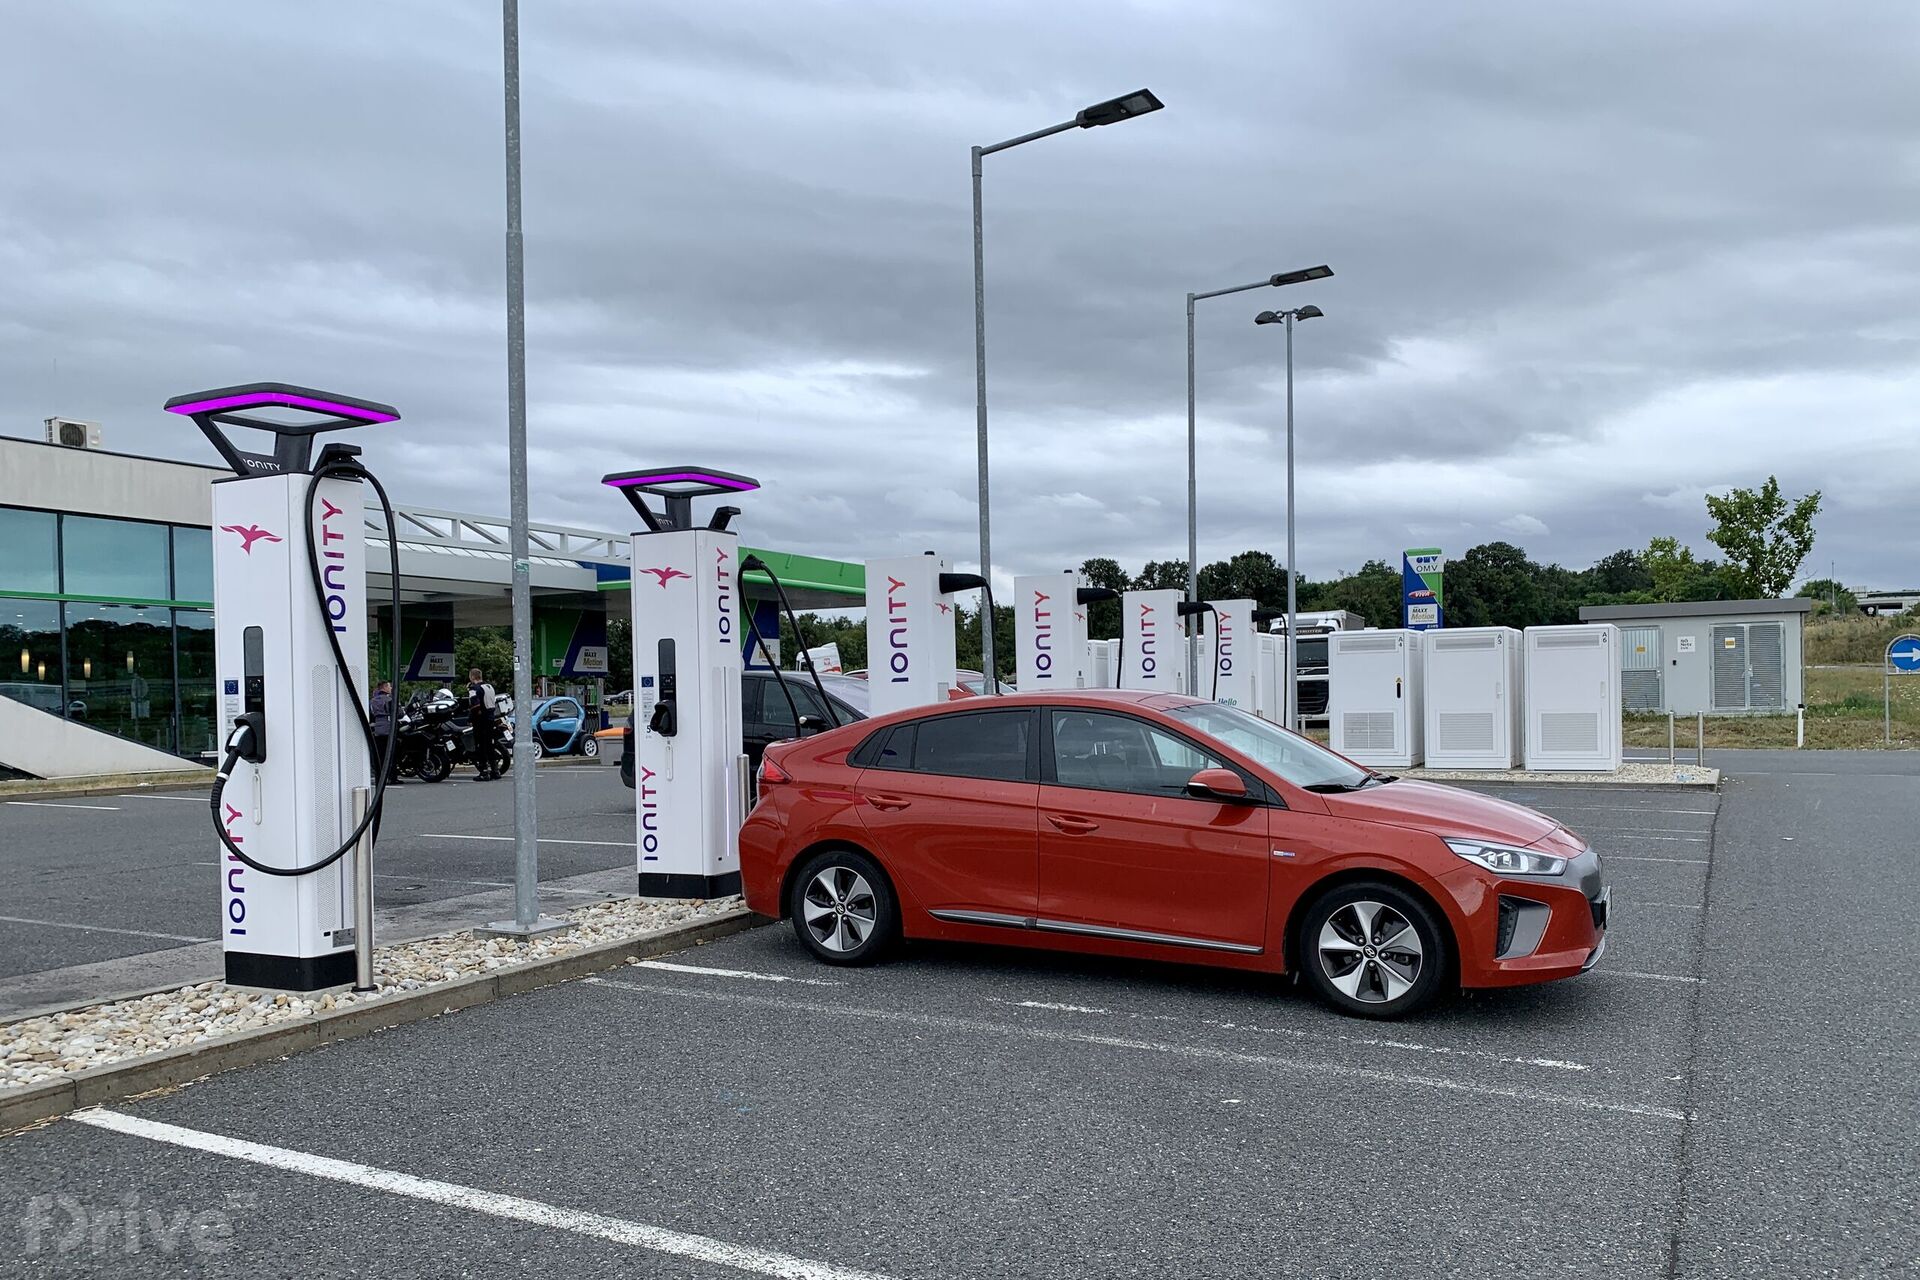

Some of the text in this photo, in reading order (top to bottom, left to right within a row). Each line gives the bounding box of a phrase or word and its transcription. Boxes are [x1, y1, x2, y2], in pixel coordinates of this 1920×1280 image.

[321, 498, 347, 633] IONITY
[716, 546, 731, 644] IONITY
[1416, 565, 1438, 573] OMV
[887, 576, 909, 683] IONITY
[1034, 591, 1052, 679] IONITY
[1140, 604, 1156, 679] IONITY
[1219, 611, 1233, 677] IONITY
[641, 766, 658, 861] IONITY
